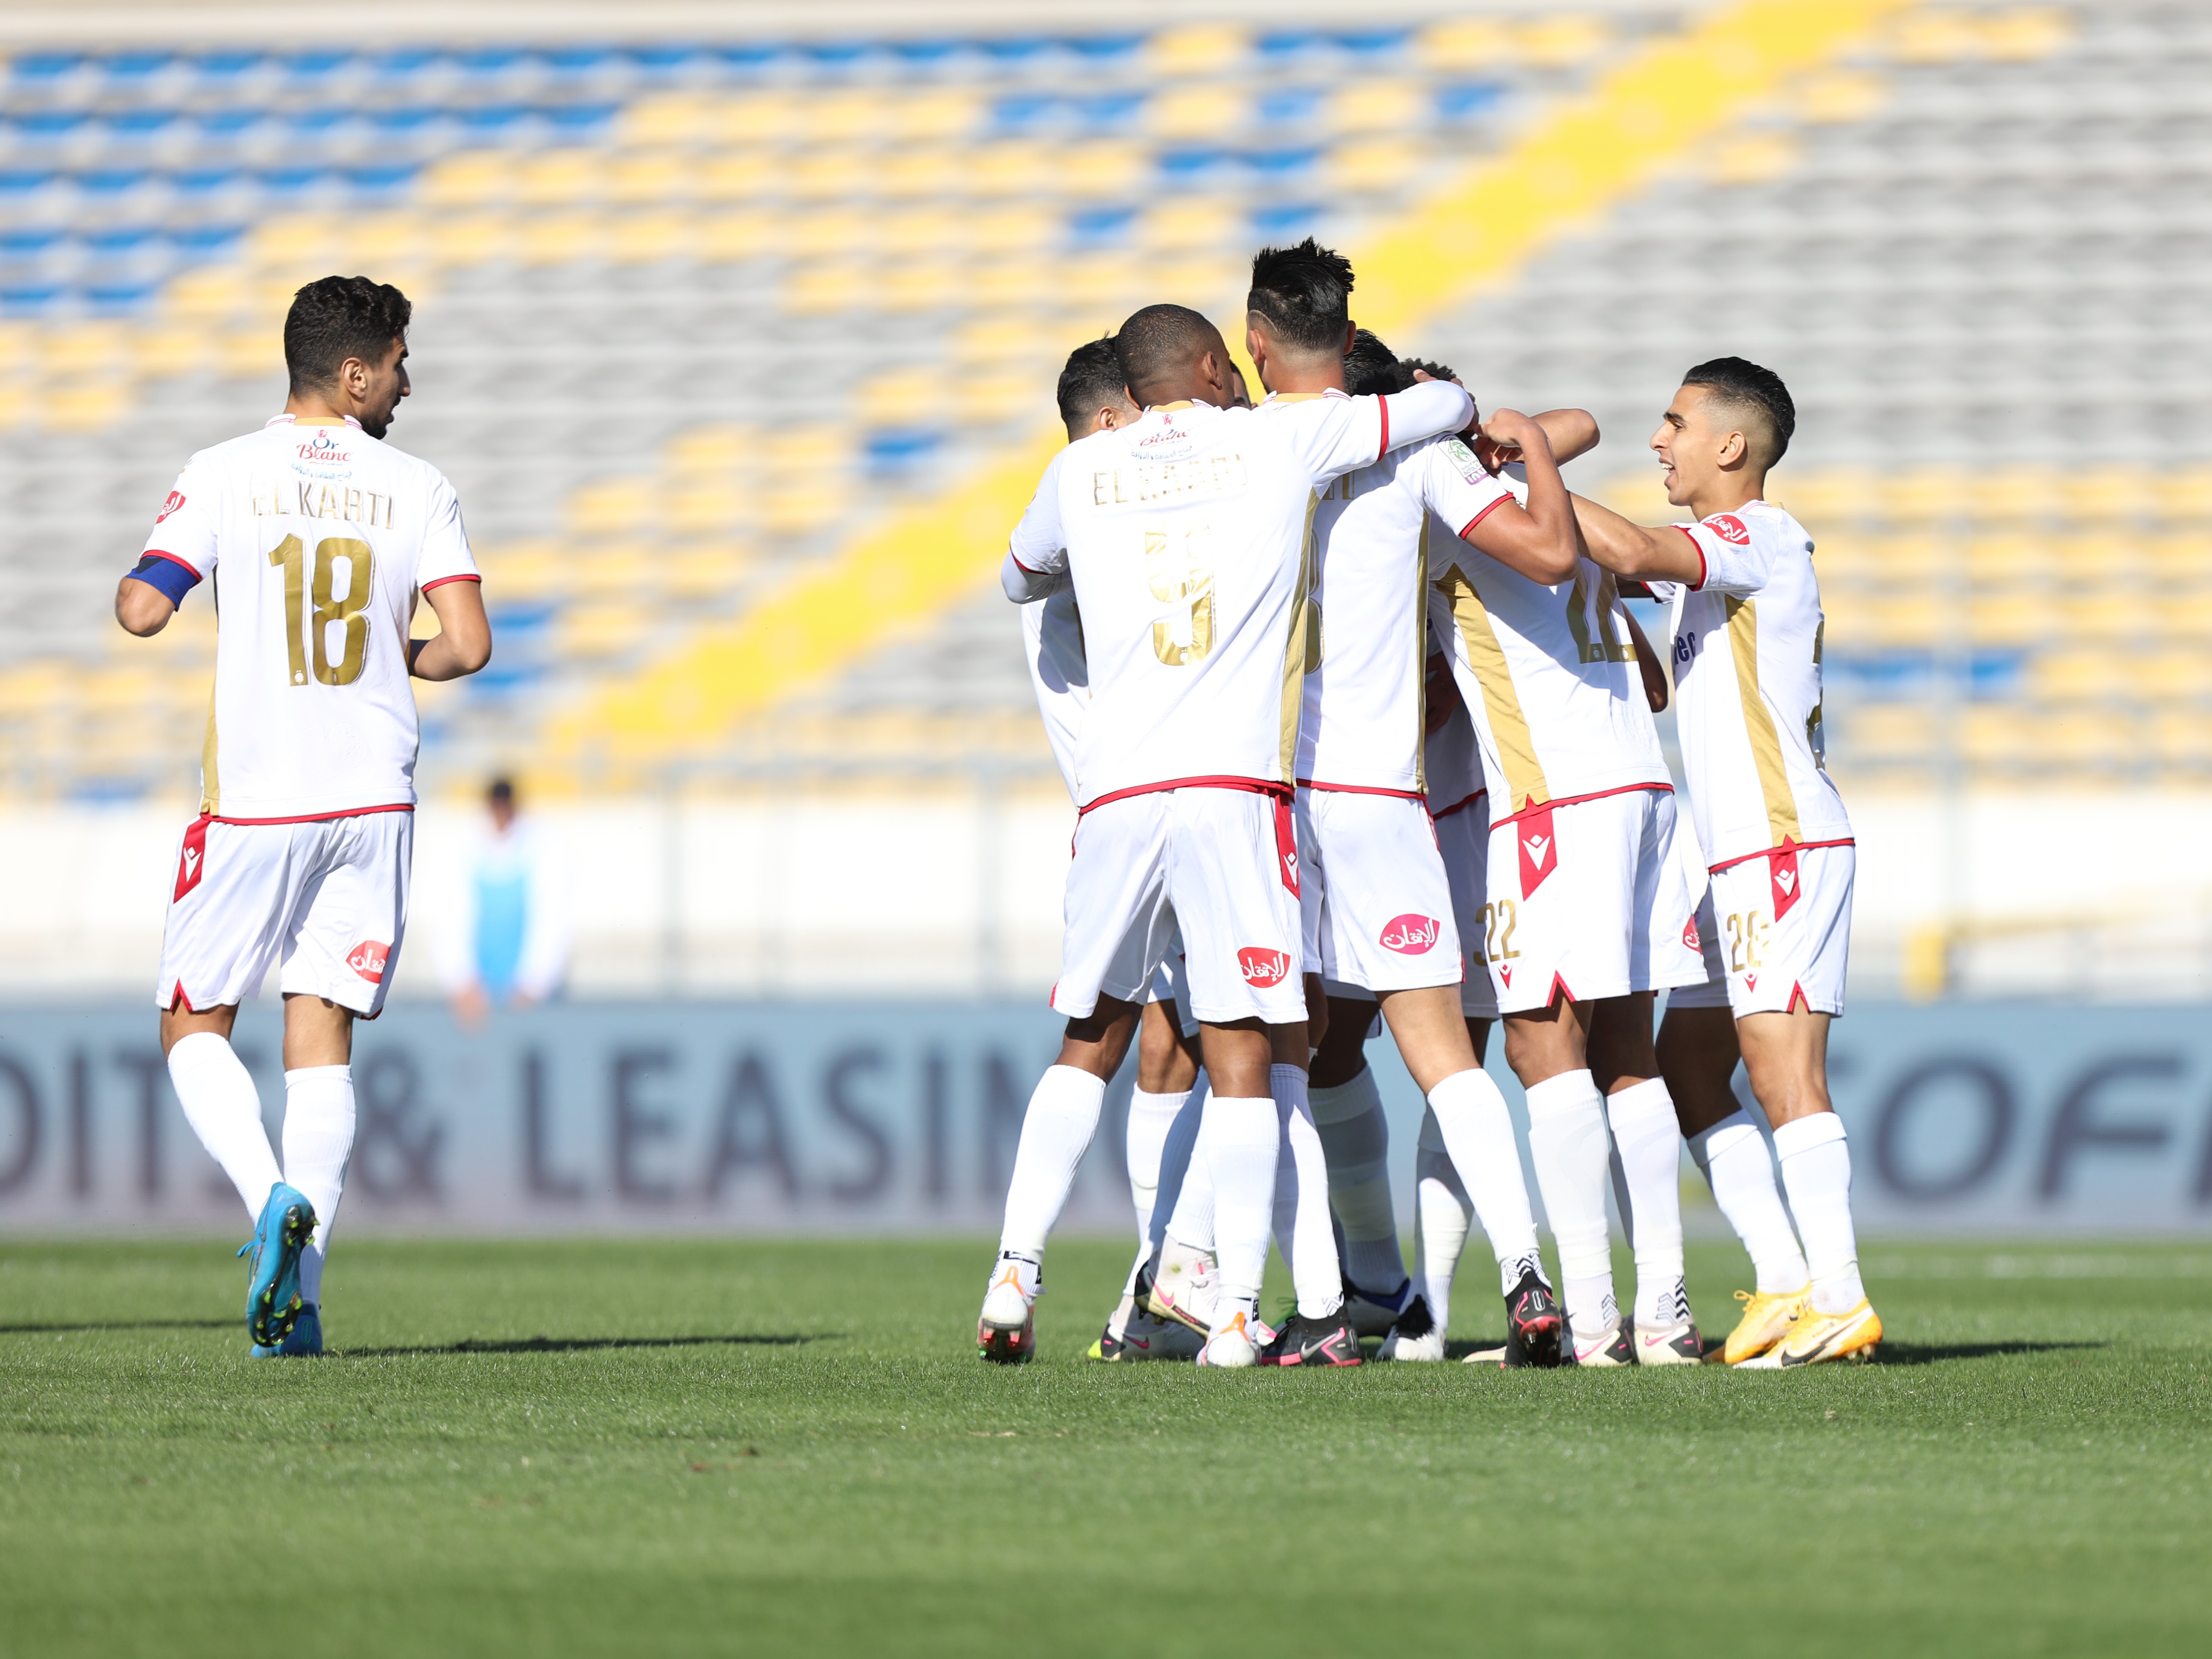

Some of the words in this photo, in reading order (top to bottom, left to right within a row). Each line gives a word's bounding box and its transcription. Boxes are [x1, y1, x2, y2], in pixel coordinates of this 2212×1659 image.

[296, 444, 351, 461] Blanc
[313, 438, 339, 449] Or
[251, 479, 290, 516] EL
[298, 480, 395, 529] KARTI
[1094, 469, 1130, 505] EL
[268, 533, 375, 686] 18
[358, 1047, 448, 1202] &
[517, 1047, 1132, 1204] LEASIN
